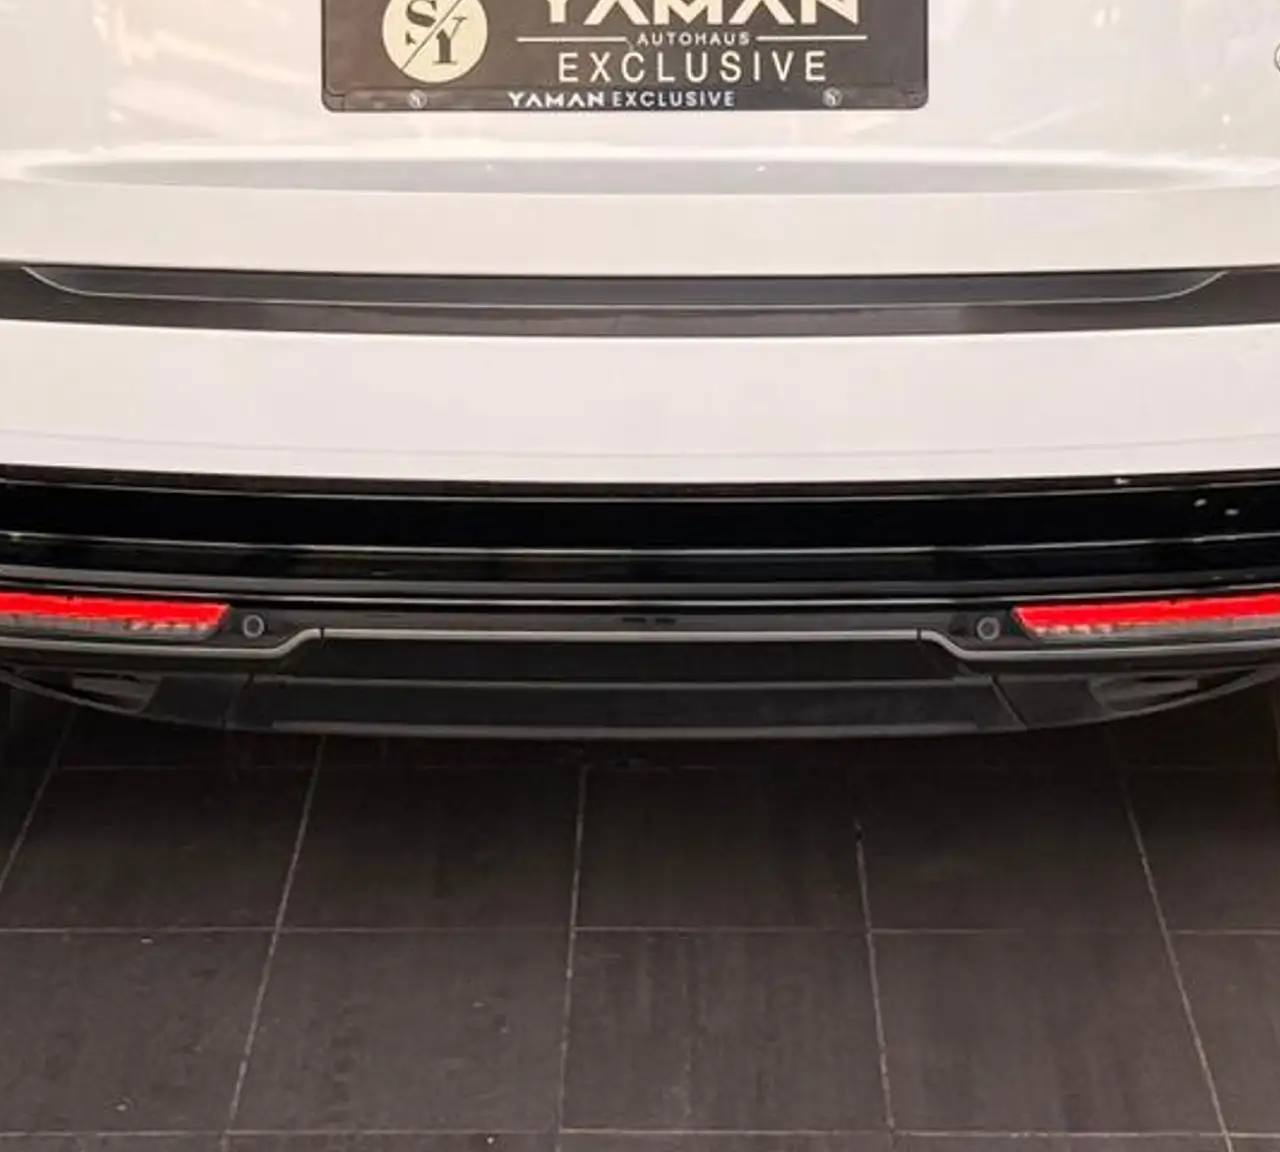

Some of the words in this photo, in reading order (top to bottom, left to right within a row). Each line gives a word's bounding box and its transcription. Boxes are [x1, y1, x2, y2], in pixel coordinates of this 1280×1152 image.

[636, 31, 750, 47] AUTOHAUS
[557, 50, 827, 83] EXCLUSIVE
[507, 91, 604, 108] YAMAN
[611, 90, 735, 108] EXCLUSIVE
